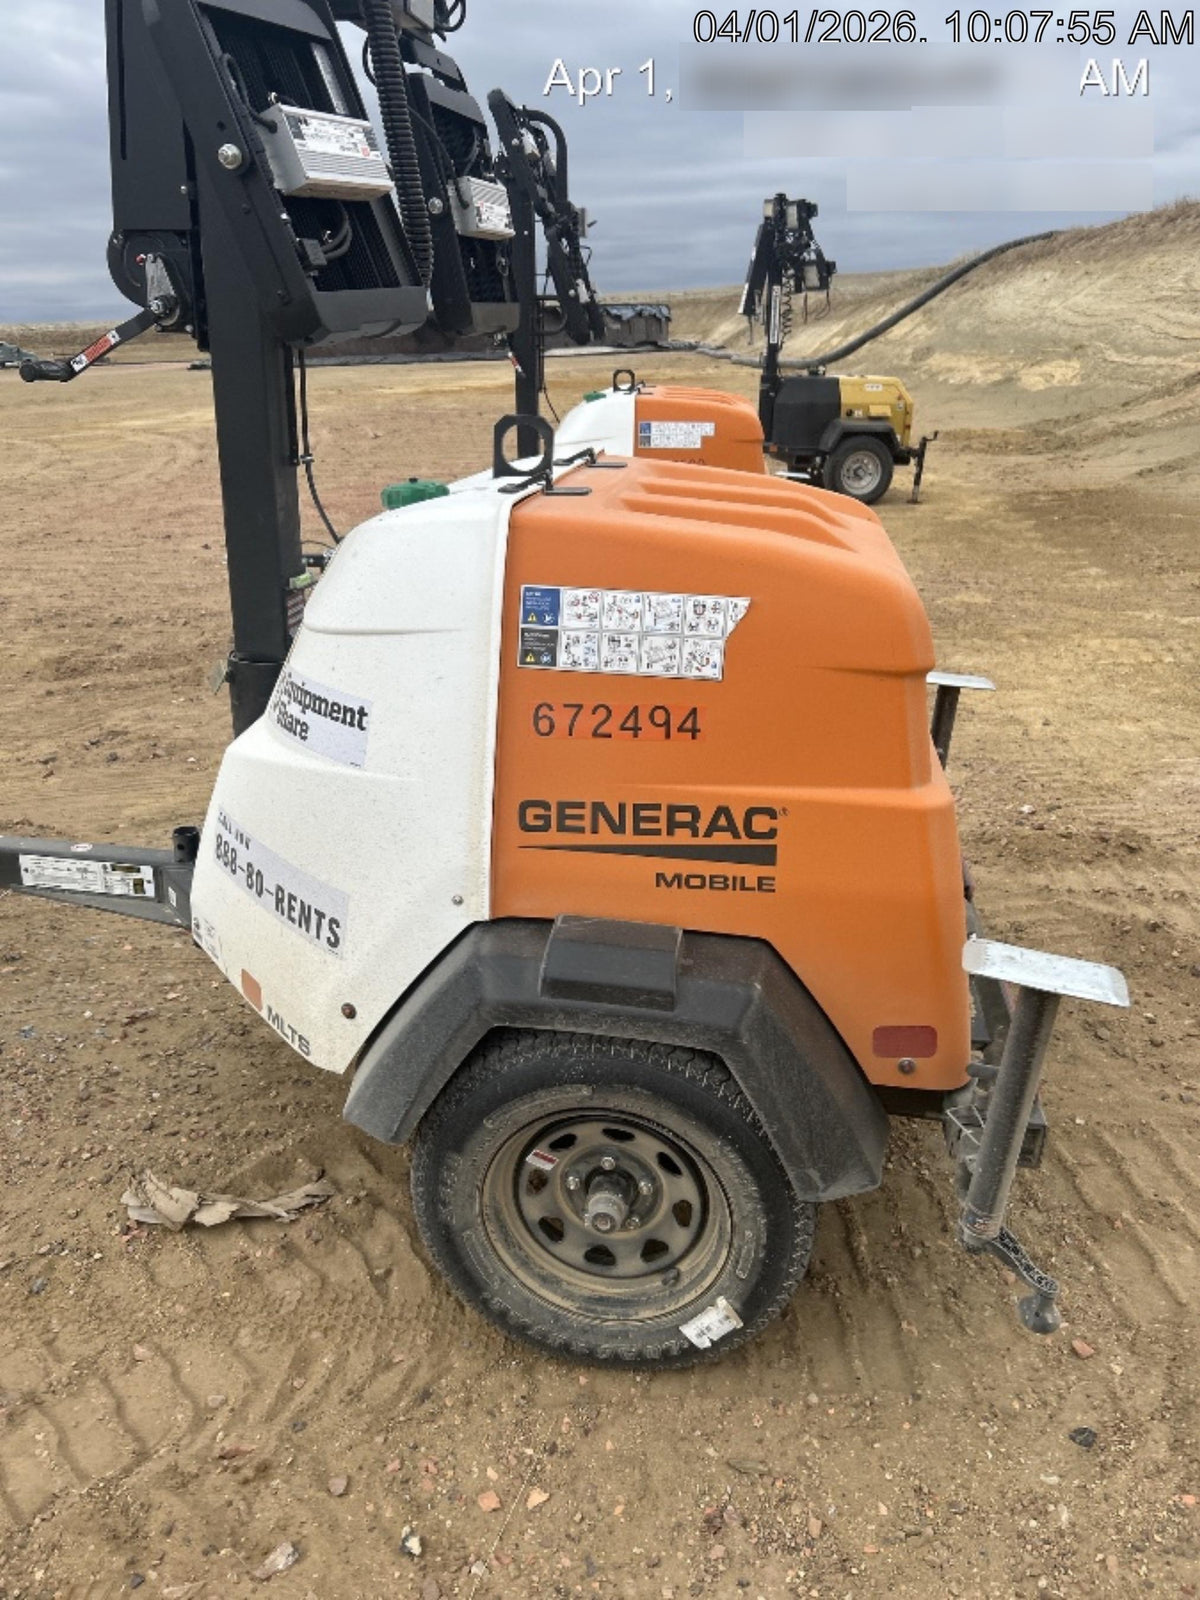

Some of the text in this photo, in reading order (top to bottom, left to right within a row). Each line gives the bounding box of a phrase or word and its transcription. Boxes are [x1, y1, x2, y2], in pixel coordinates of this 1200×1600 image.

[532, 702, 702, 740] 672494
[518, 799, 778, 840] GENERAC
[215, 833, 341, 949] 888-80-RENTS
[655, 872, 776, 893] MOBILE
